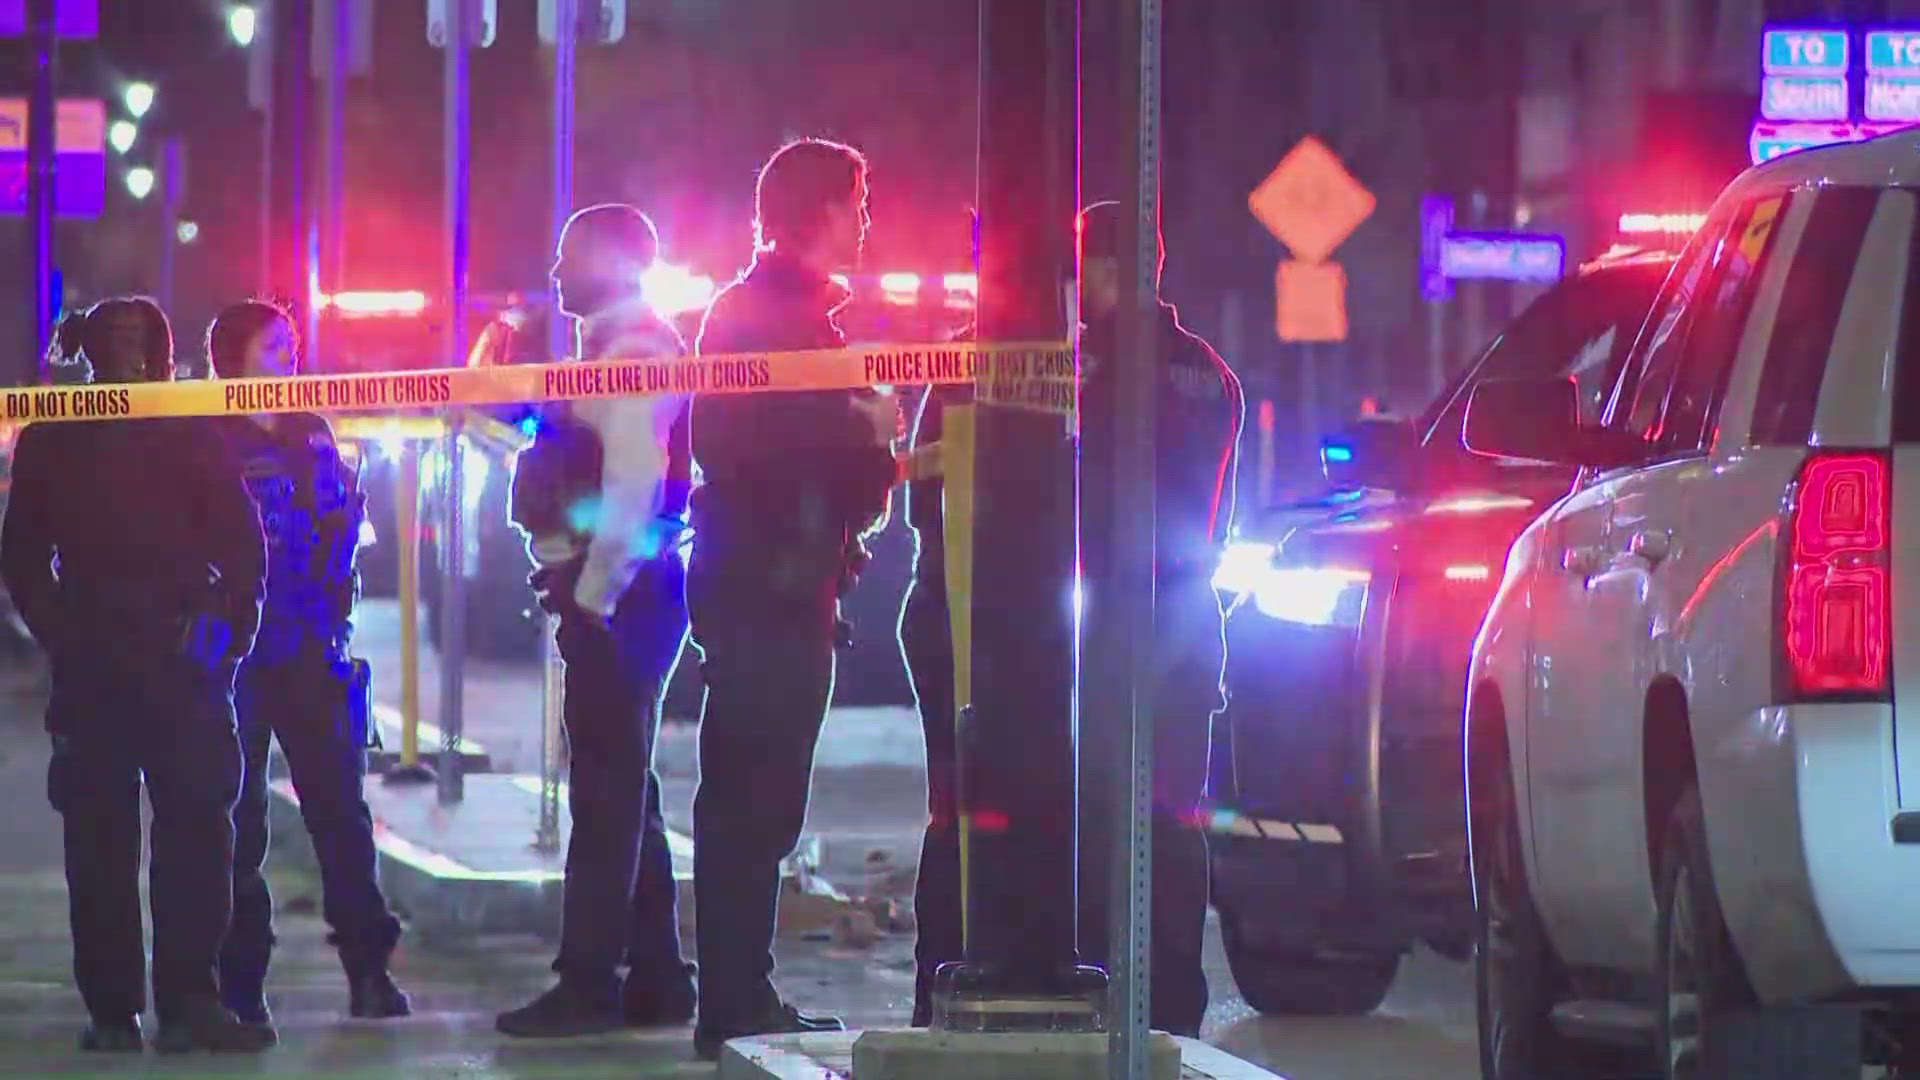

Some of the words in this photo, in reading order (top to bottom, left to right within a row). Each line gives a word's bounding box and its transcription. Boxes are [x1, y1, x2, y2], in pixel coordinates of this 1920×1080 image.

[1785, 36, 1826, 65] TO
[544, 366, 604, 397] POLICE
[607, 365, 643, 393] LINE
[646, 364, 670, 391] DO
[675, 361, 708, 391] NOT
[712, 359, 770, 388] CROSS
[865, 353, 923, 382] POLICE
[927, 351, 962, 379] LINE
[7, 393, 30, 418] DO
[34, 391, 68, 417] NOT
[72, 388, 130, 417] CROSS
[224, 383, 283, 410] POLICE
[287, 381, 323, 407] LINE
[327, 379, 350, 405] DO
[355, 377, 388, 404] NOT
[393, 375, 450, 402] CROSS
